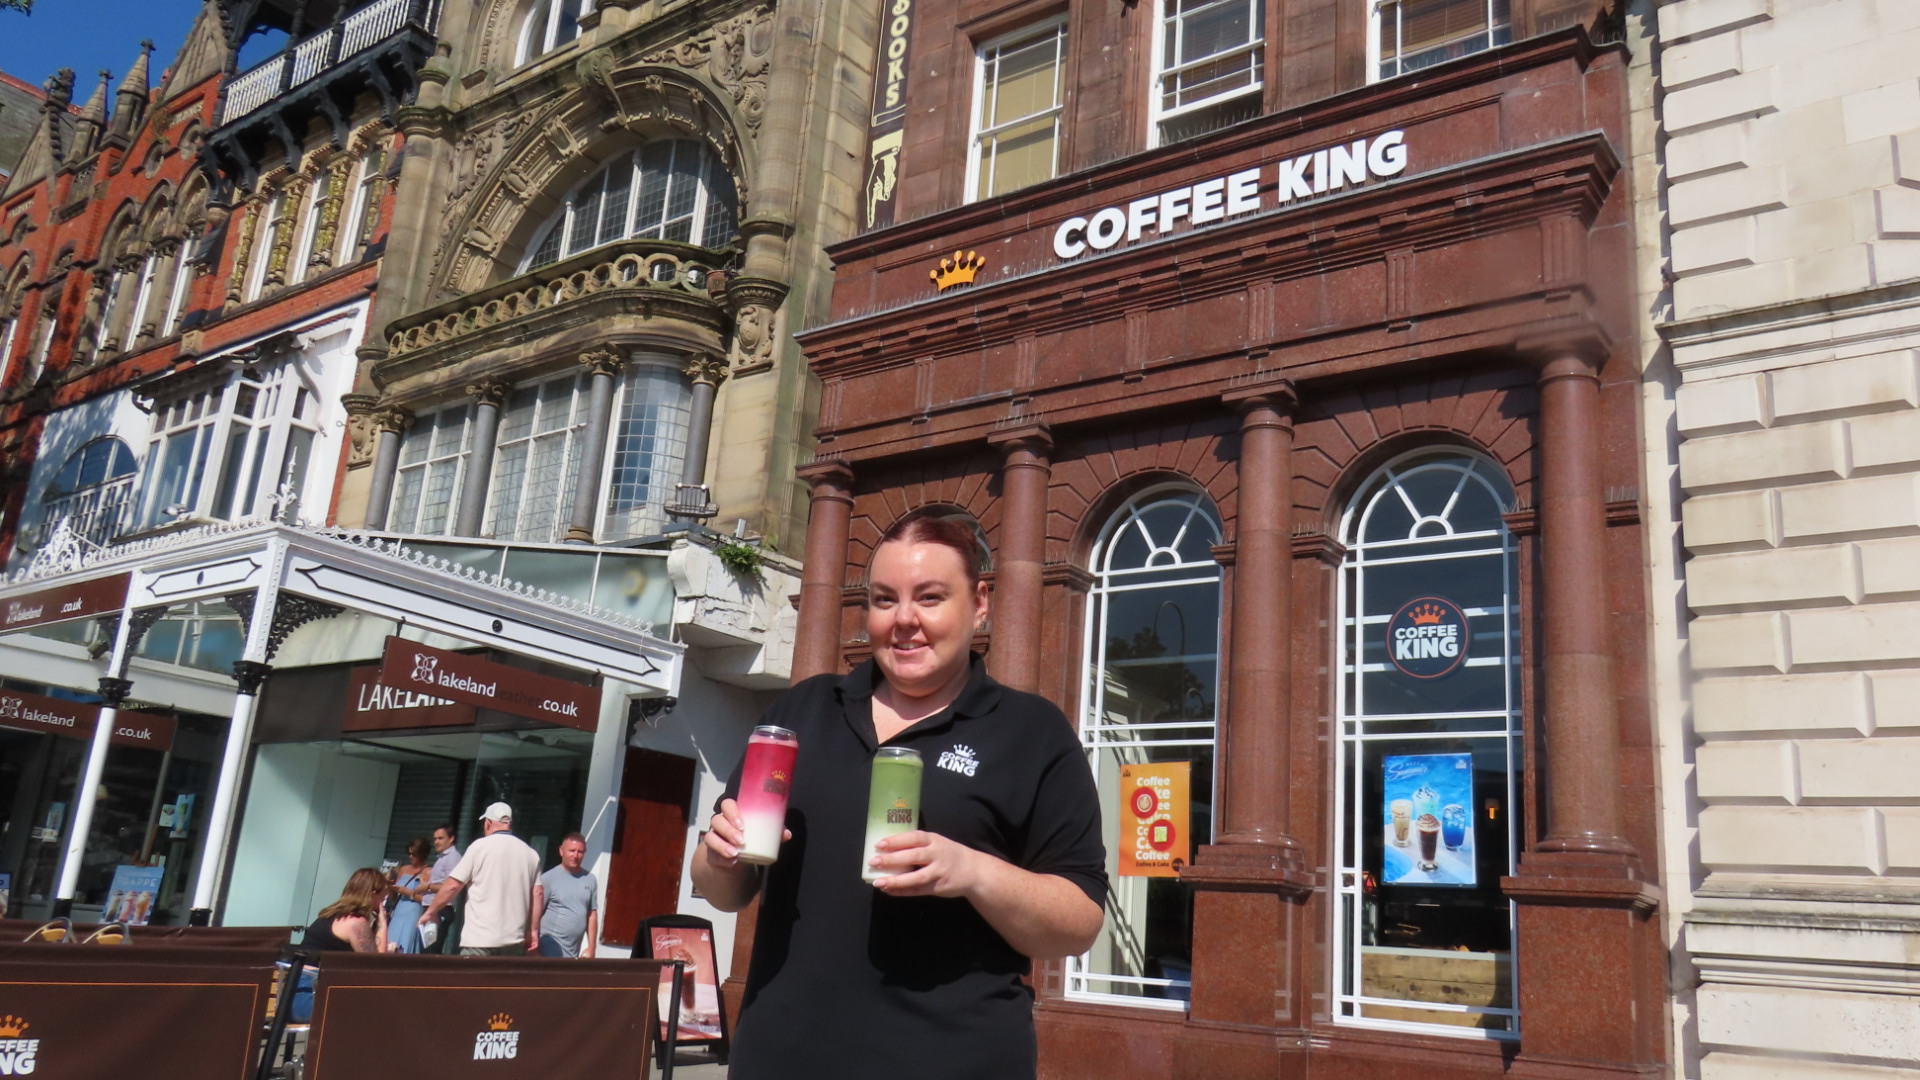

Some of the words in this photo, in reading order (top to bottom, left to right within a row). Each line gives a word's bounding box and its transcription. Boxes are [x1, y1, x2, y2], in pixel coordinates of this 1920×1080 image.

[1053, 167, 1261, 259] COFFEE
[1278, 130, 1408, 204] KING
[60, 596, 83, 614] .co.uk
[1394, 624, 1458, 640] COFFEE
[1396, 636, 1459, 660] KING
[438, 670, 497, 698] lakeland
[537, 699, 579, 718] .co.uk
[22, 708, 76, 727] lakeland
[115, 727, 152, 740] .co.uk
[936, 756, 976, 777] KING
[940, 751, 980, 768] COFFEE
[1136, 776, 1171, 786] Coffee
[887, 814, 913, 824] KING
[1135, 851, 1170, 861] Coffee
[476, 1031, 520, 1042] COFFEE
[473, 1040, 518, 1060] KING
[0, 1051, 36, 1075] NG
